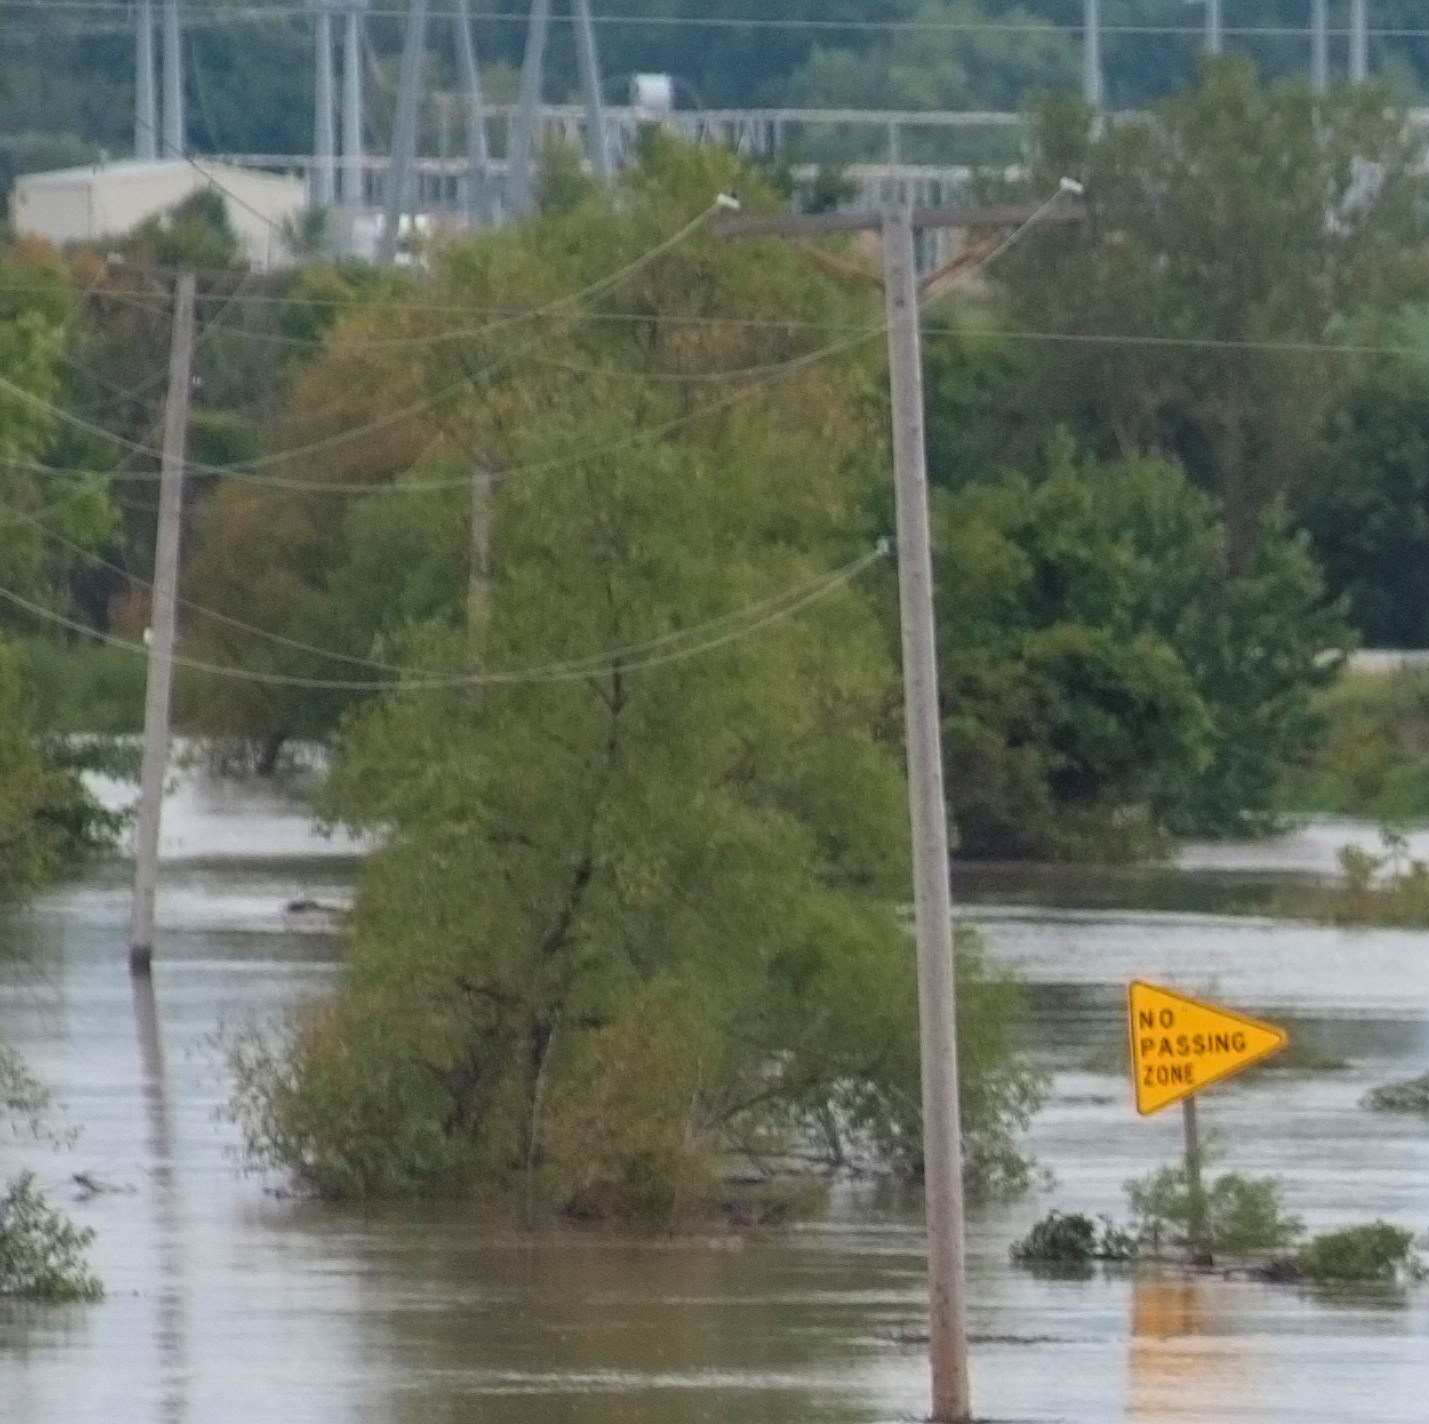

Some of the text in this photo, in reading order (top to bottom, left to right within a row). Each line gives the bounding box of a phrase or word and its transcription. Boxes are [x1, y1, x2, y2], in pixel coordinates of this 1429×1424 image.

[1139, 1008, 1174, 1029] NO
[1140, 1031, 1247, 1057] PASSING
[1143, 1062, 1194, 1087] ZONE
